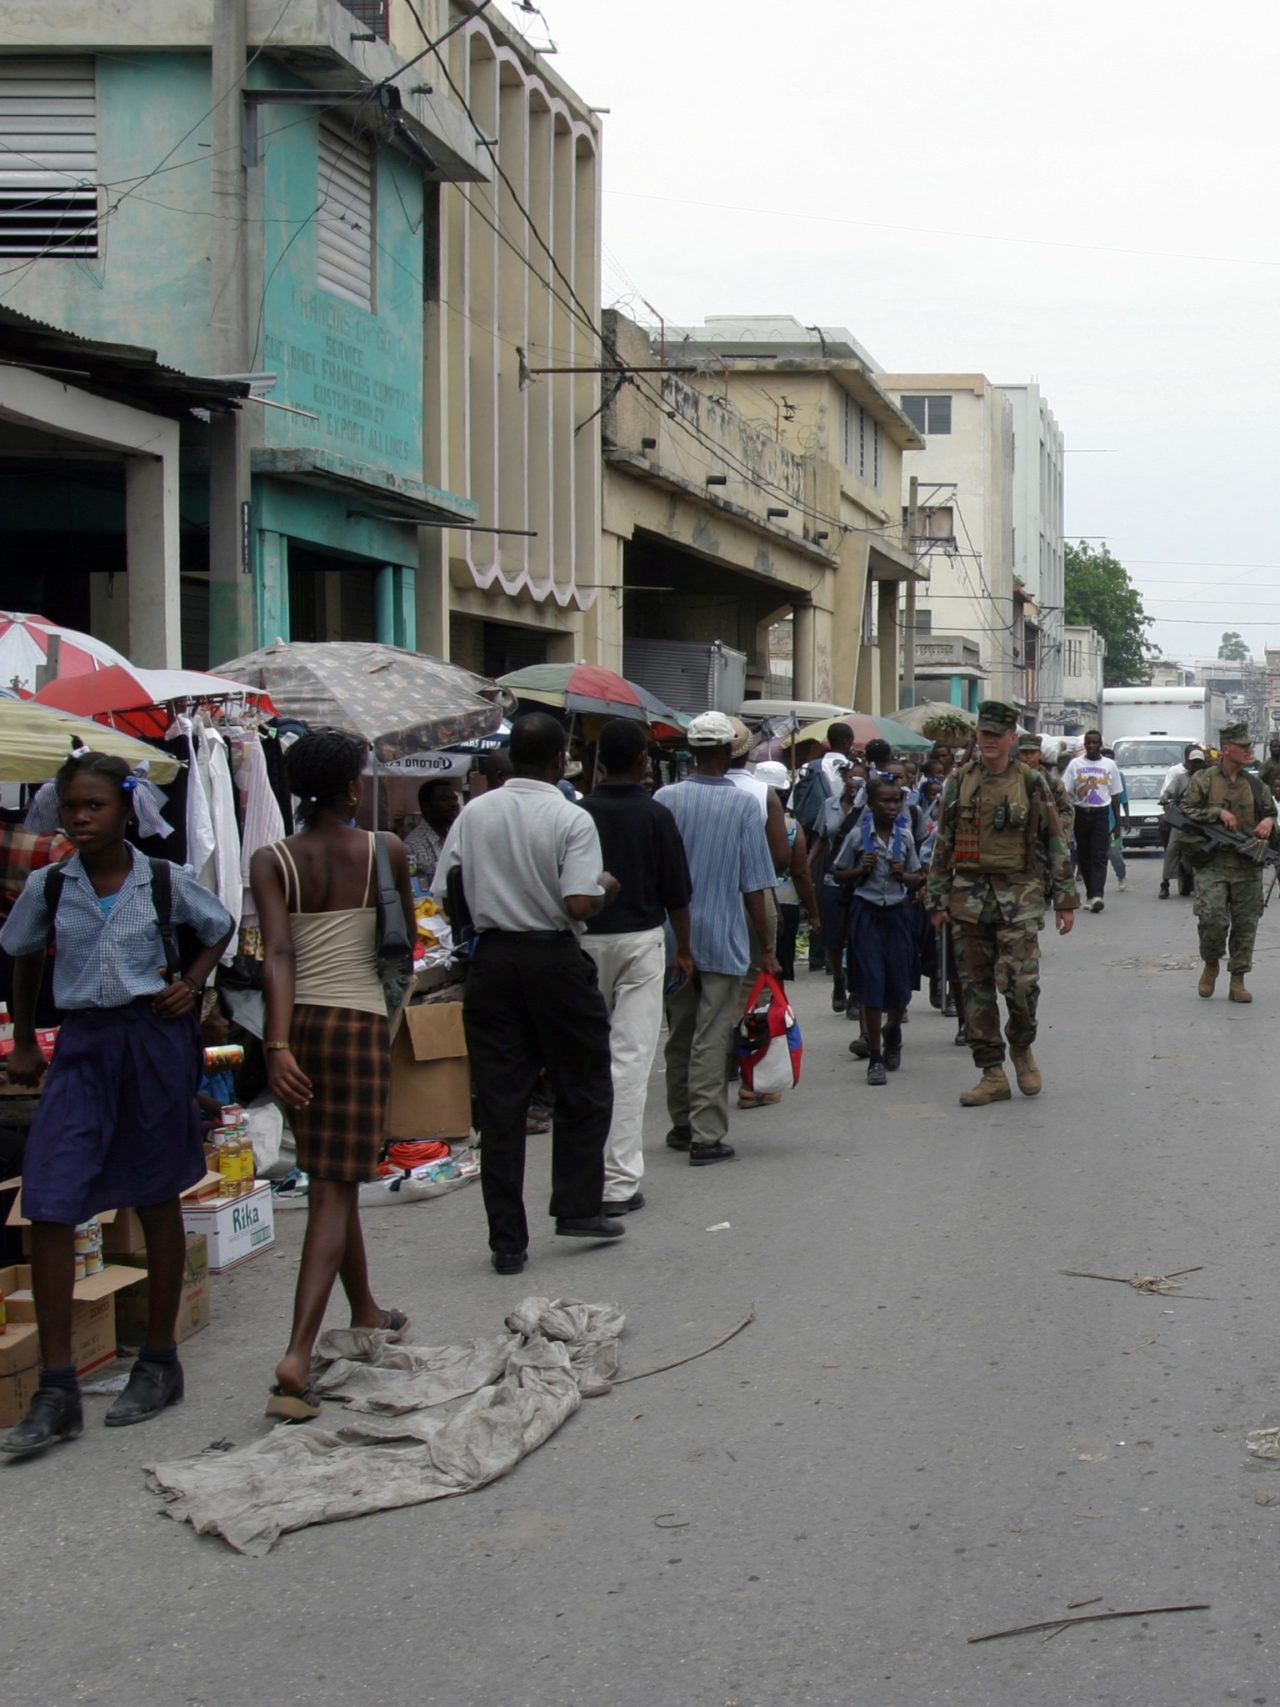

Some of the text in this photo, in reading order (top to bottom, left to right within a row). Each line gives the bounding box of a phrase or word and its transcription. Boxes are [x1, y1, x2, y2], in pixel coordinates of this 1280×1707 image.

[326, 335, 365, 368] SERVICE
[313, 383, 351, 414] CUSTOM
[327, 413, 365, 445] EXPORT
[232, 1203, 260, 1233] Rika
